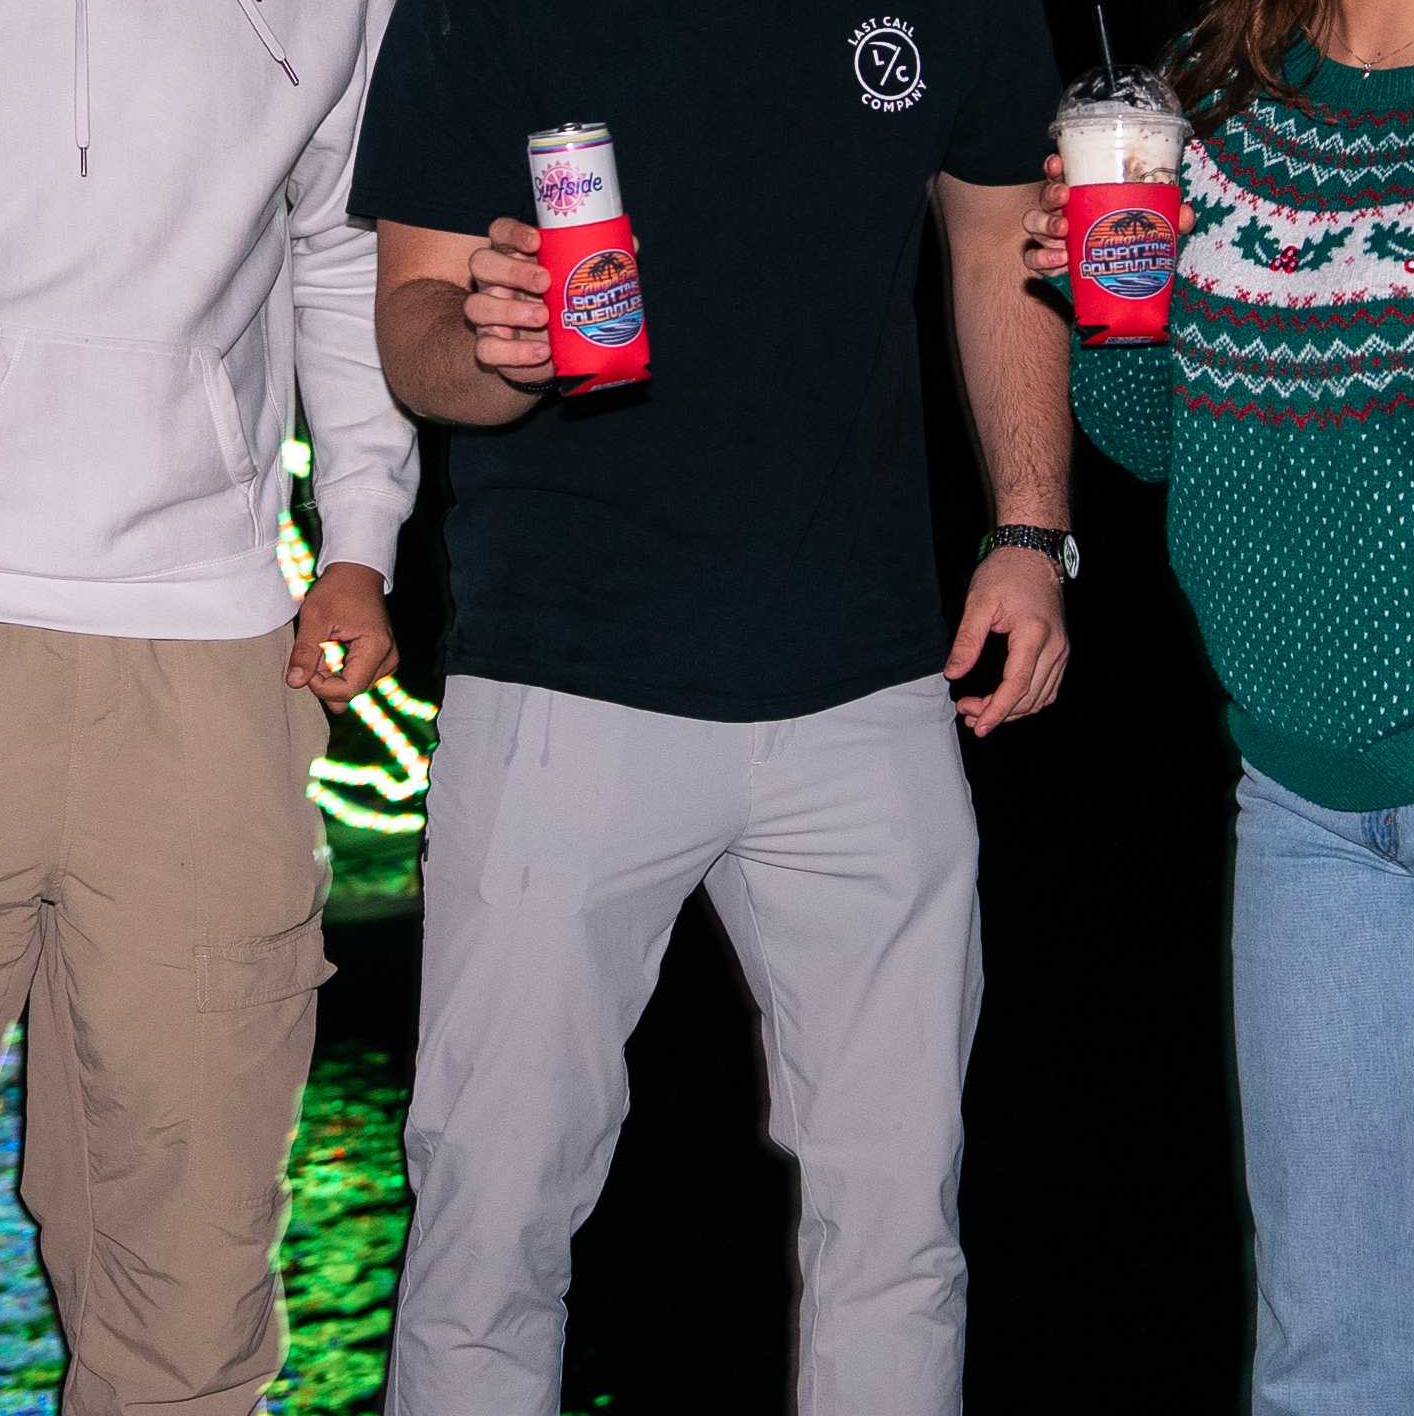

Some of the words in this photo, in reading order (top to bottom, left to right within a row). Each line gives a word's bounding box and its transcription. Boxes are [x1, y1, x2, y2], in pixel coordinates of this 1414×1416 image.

[847, 18, 877, 46] LAST
[883, 16, 914, 37] CALL
[861, 79, 927, 113] COMPANY
[534, 172, 603, 201] Surfside
[1082, 257, 1176, 276] ADVENTURE
[1091, 243, 1171, 261] BOATING
